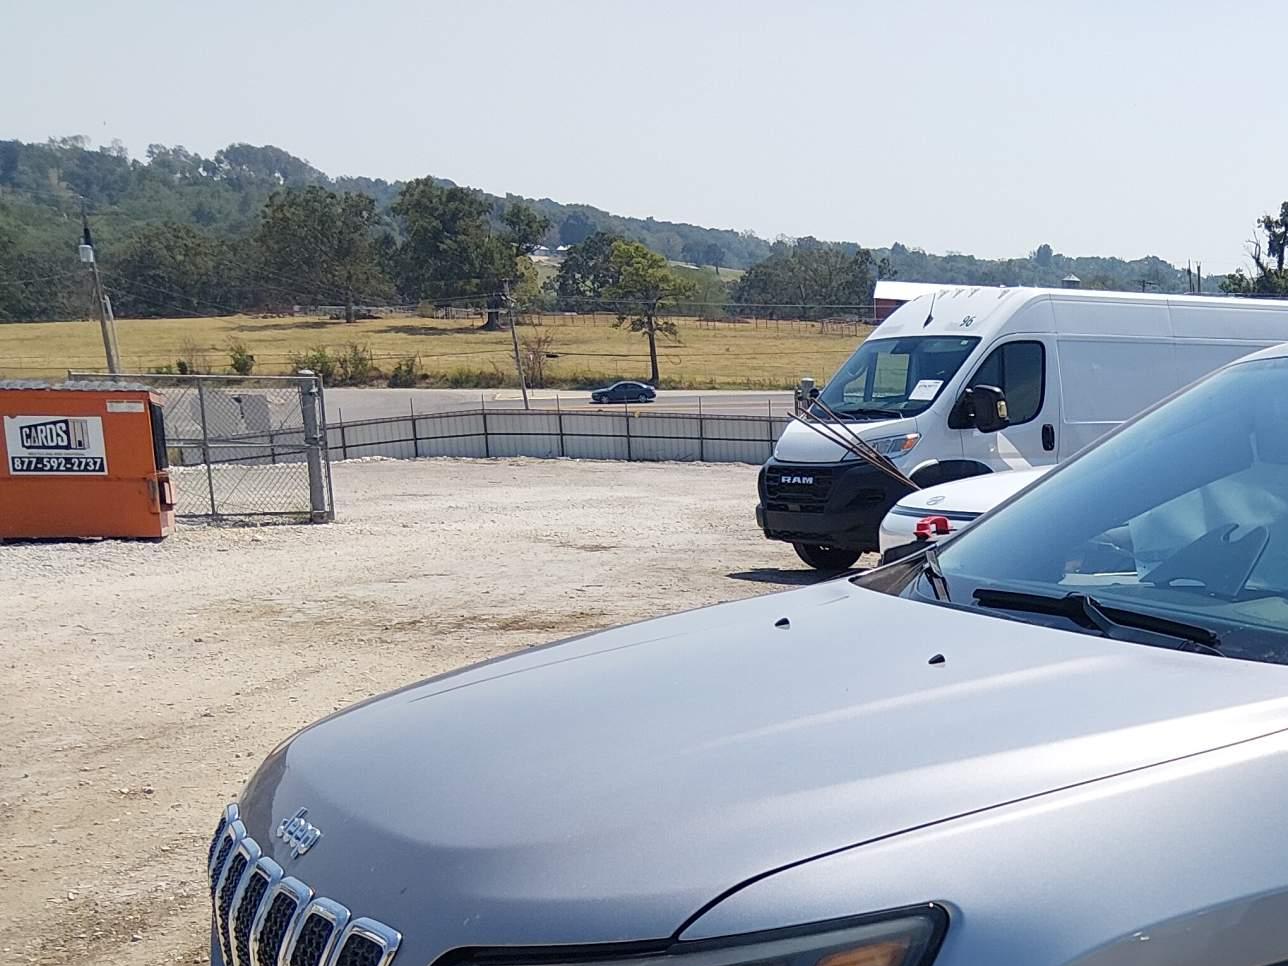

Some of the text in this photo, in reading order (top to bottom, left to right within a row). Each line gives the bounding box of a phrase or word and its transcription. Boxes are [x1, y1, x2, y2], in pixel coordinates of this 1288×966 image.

[22, 422, 68, 447] CARDS
[14, 457, 102, 471] 877-592-2737
[781, 475, 814, 485] RAM
